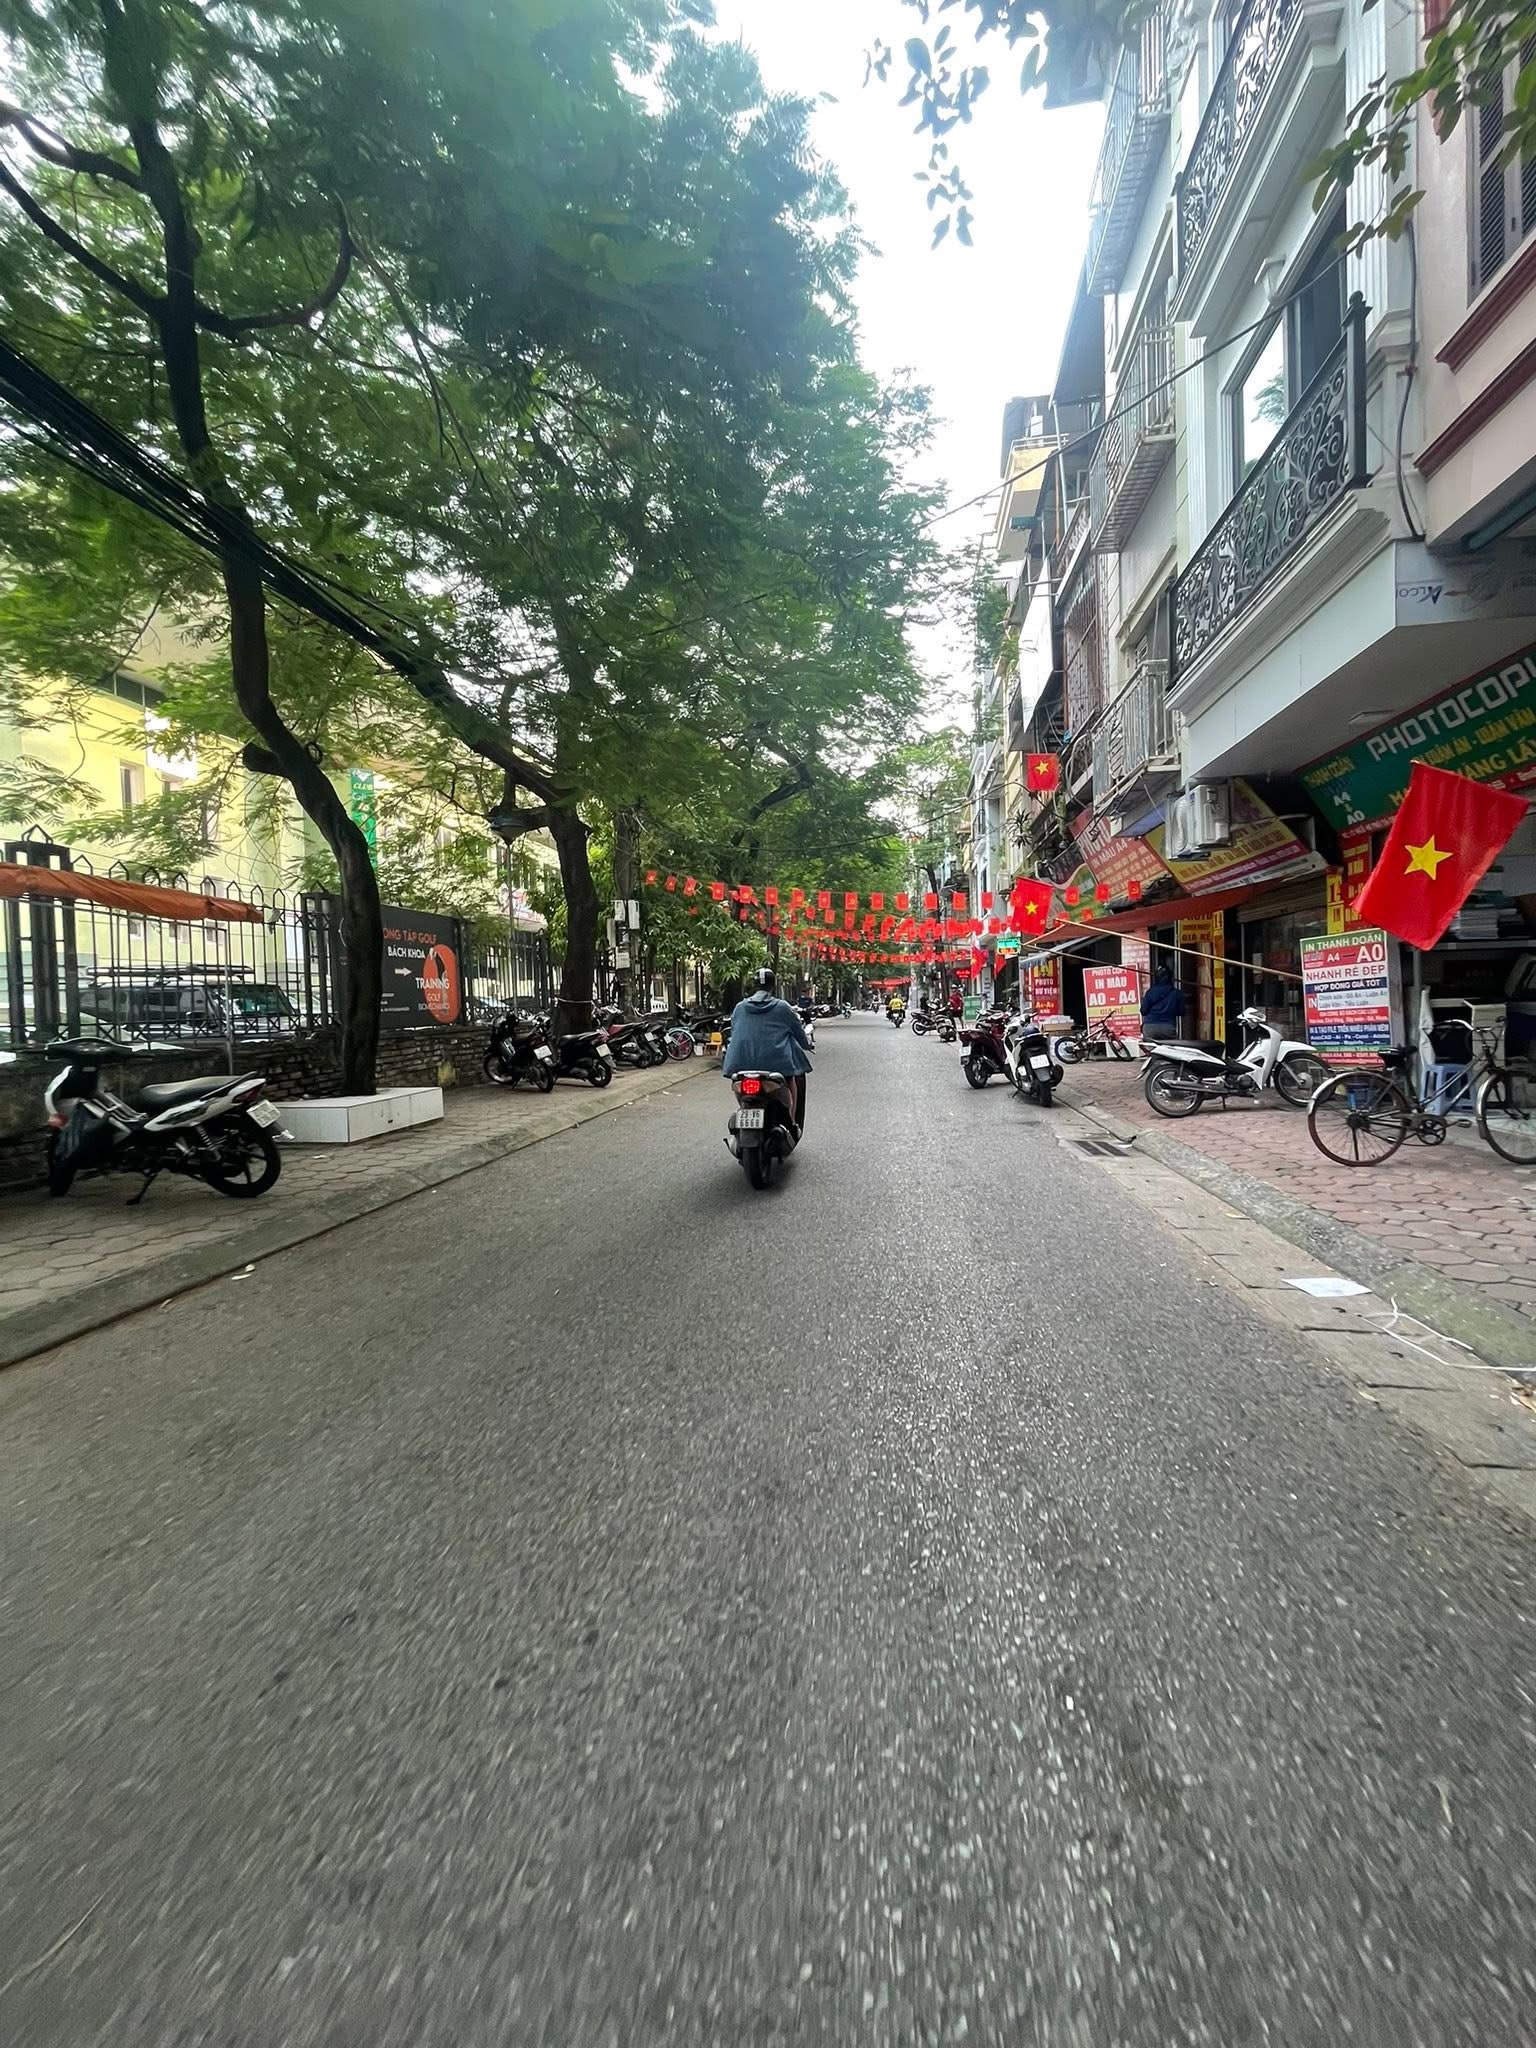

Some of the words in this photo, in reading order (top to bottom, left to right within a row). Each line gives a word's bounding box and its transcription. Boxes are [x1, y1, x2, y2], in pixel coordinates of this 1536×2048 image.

[388, 944, 407, 957] BÁCH
[408, 948, 426, 959] KHOA
[1305, 943, 1315, 952] IN
[1317, 938, 1349, 950] THANH
[1327, 953, 1340, 962] A4
[1357, 944, 1384, 963] A0
[1306, 969, 1342, 981] NHANH
[415, 977, 449, 989] TRAINING
[1095, 978, 1104, 989] IN
[1119, 990, 1137, 1004] A4
